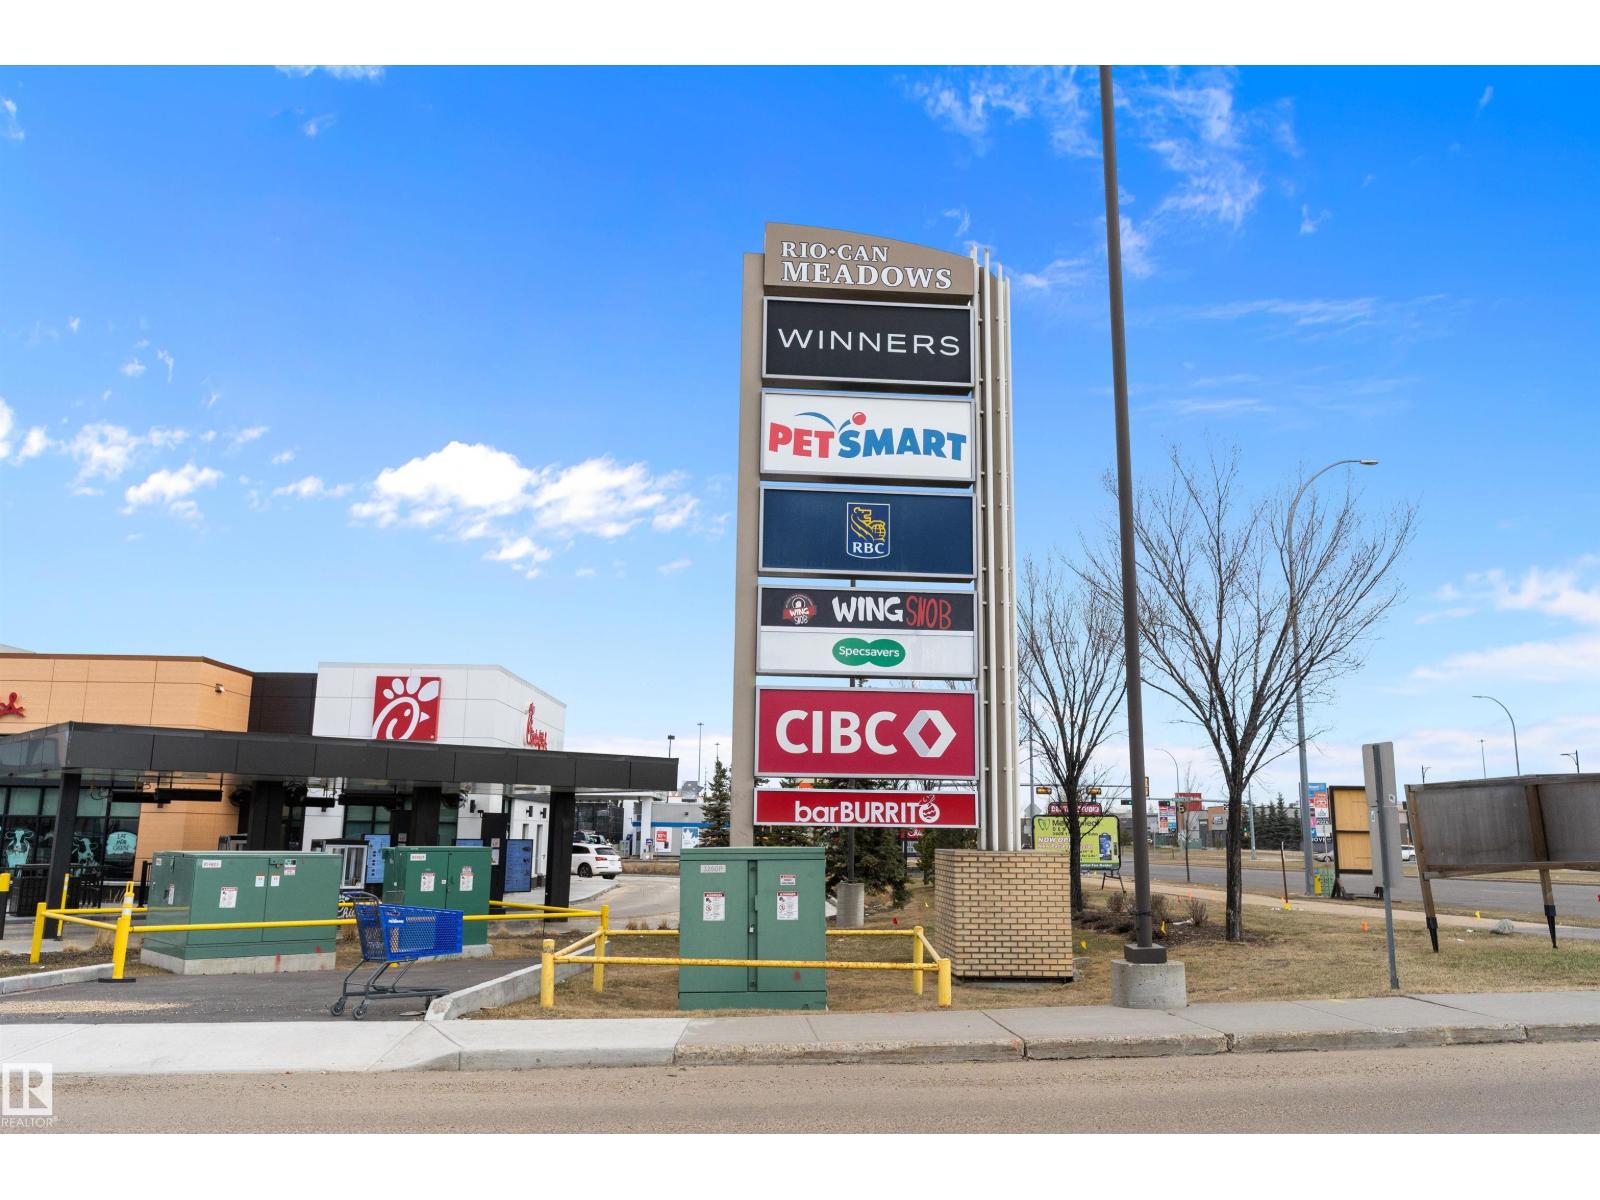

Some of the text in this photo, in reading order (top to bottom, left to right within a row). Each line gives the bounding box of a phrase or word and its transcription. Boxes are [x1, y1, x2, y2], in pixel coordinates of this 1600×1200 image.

[781, 261, 953, 290] MEADOWS
[777, 328, 960, 356] WINNERS
[852, 541, 885, 554] RBC
[831, 596, 903, 623] WING
[905, 595, 952, 630] SNOB
[838, 646, 900, 658] Specsavers
[775, 709, 898, 756] CIBC
